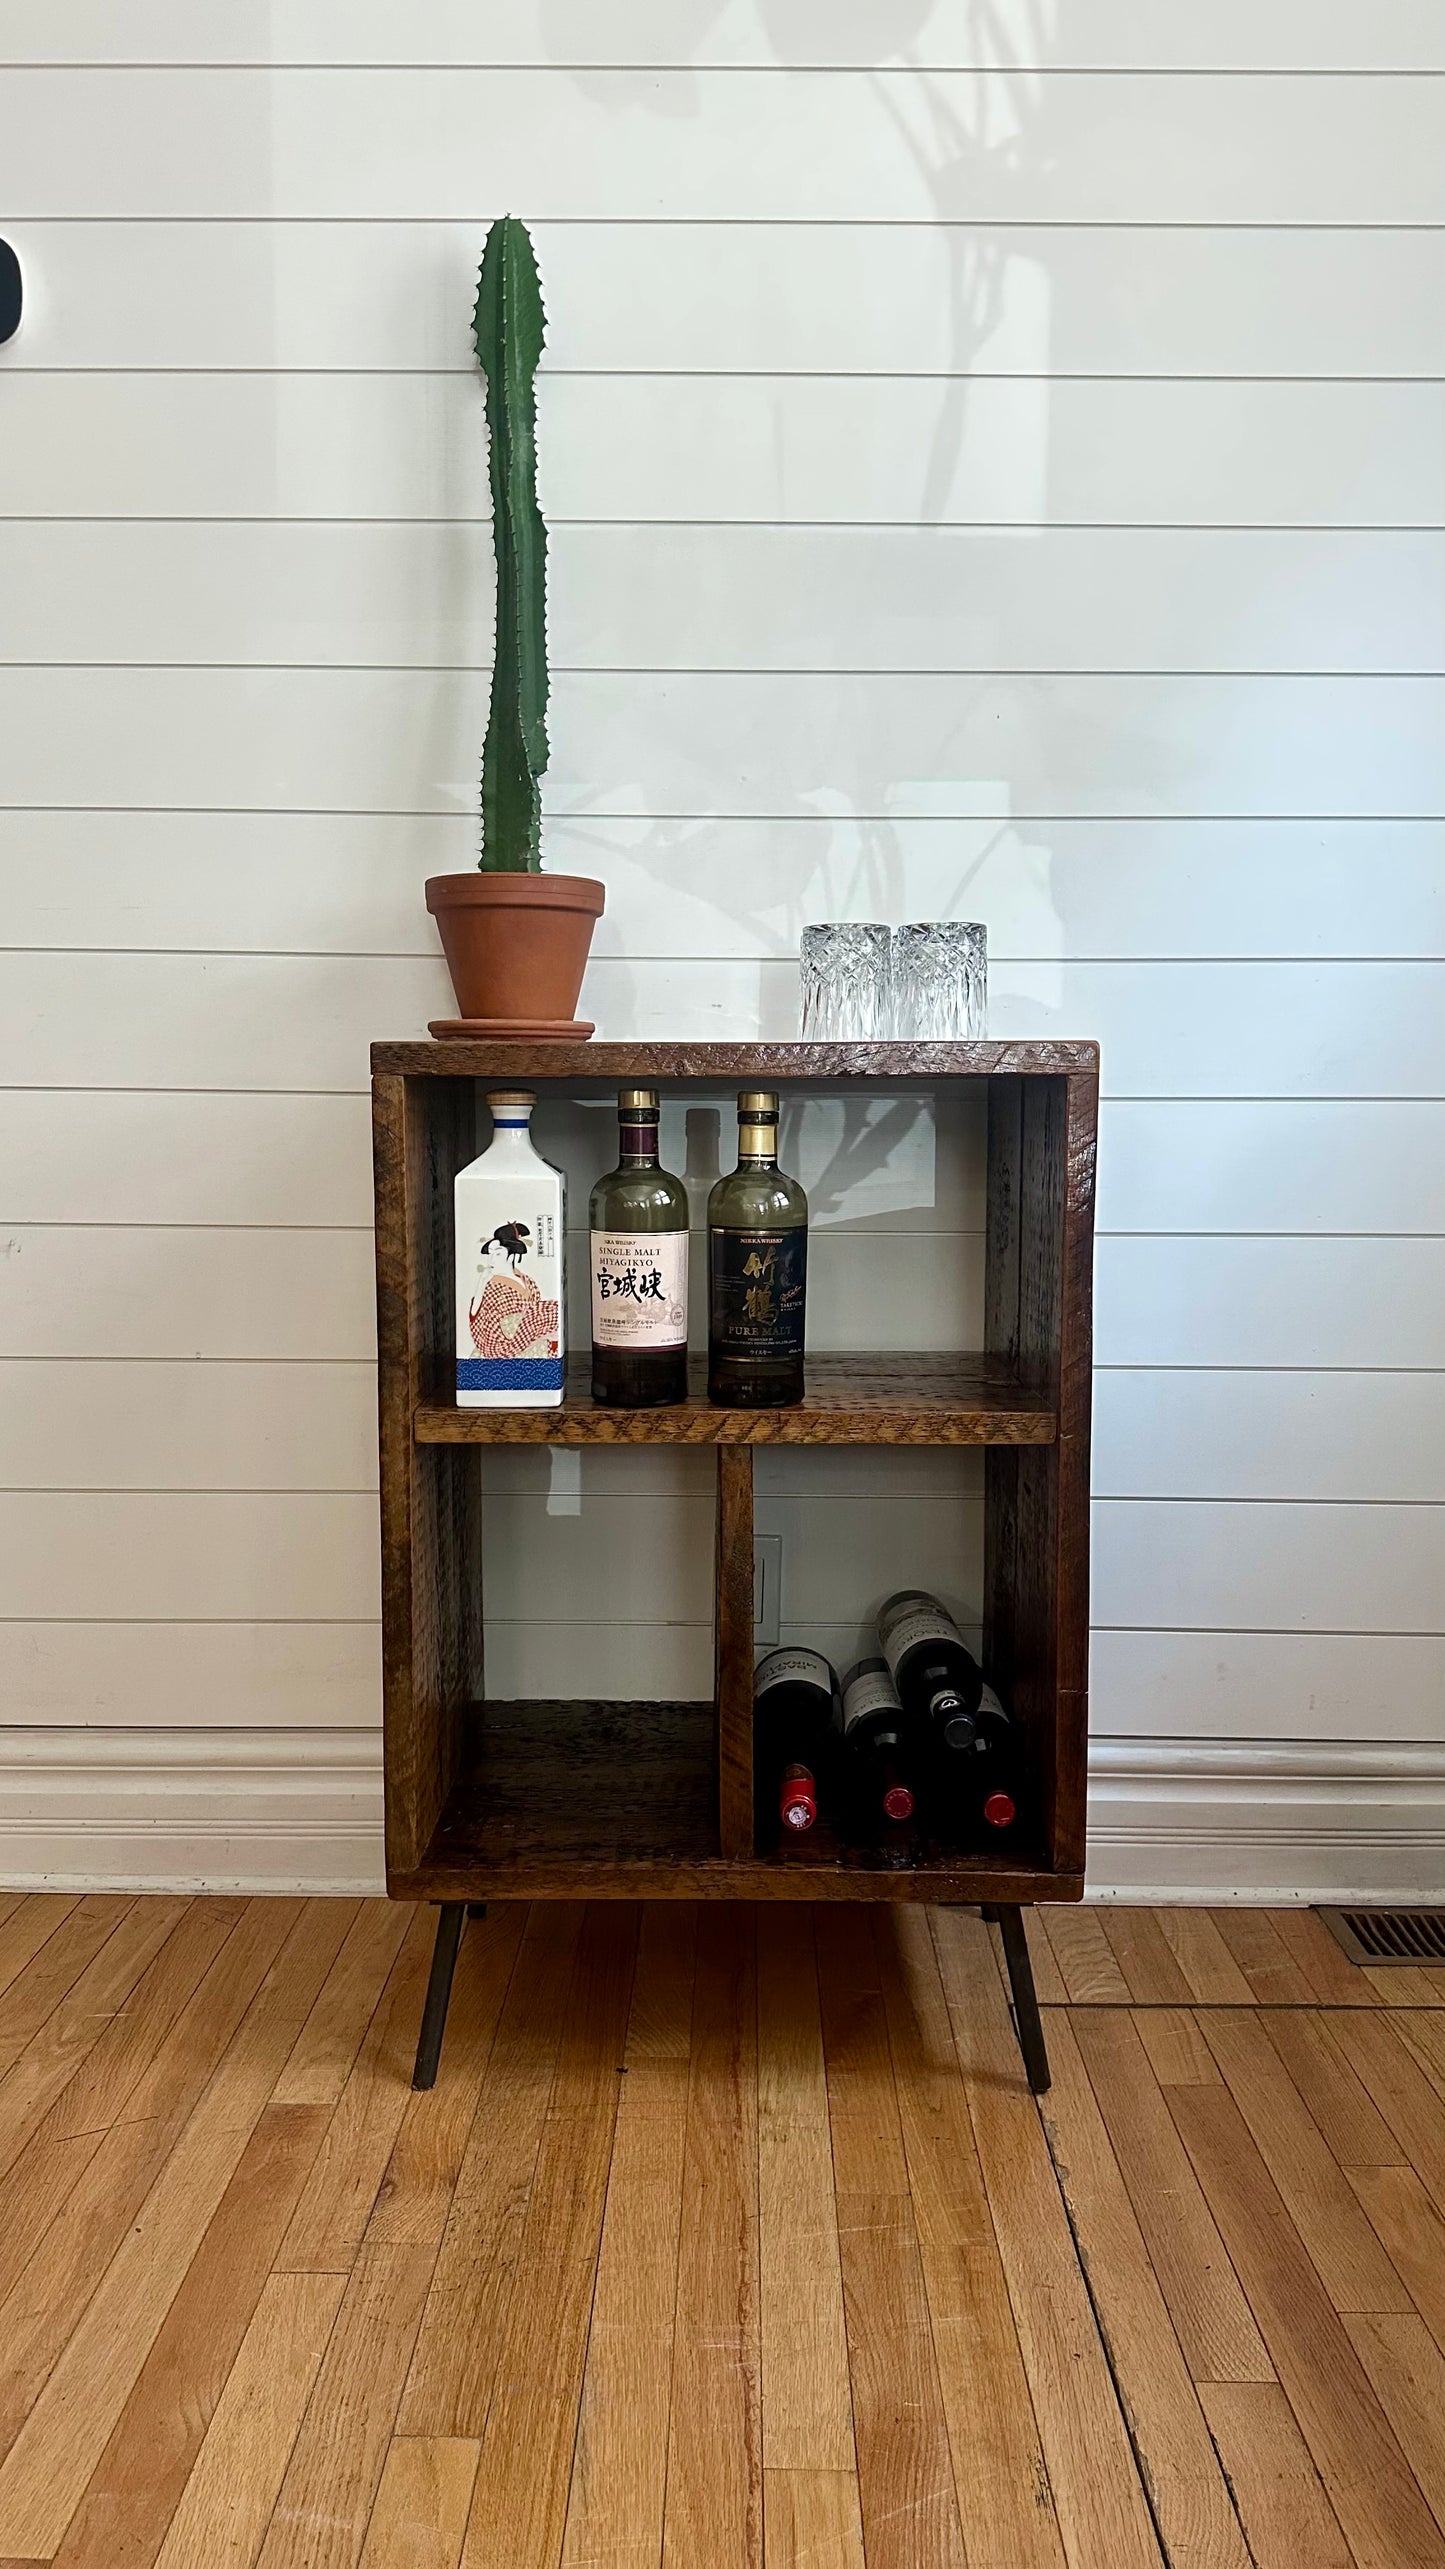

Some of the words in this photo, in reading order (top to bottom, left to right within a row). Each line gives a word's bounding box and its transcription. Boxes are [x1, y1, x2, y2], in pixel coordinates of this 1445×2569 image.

[599, 1247, 631, 1256] SINGLE
[600, 1258, 653, 1266] MIYAGIKYO
[597, 1267, 666, 1303] 宮城峡
[728, 1326, 759, 1336] PURE
[762, 1326, 793, 1336] MALT
